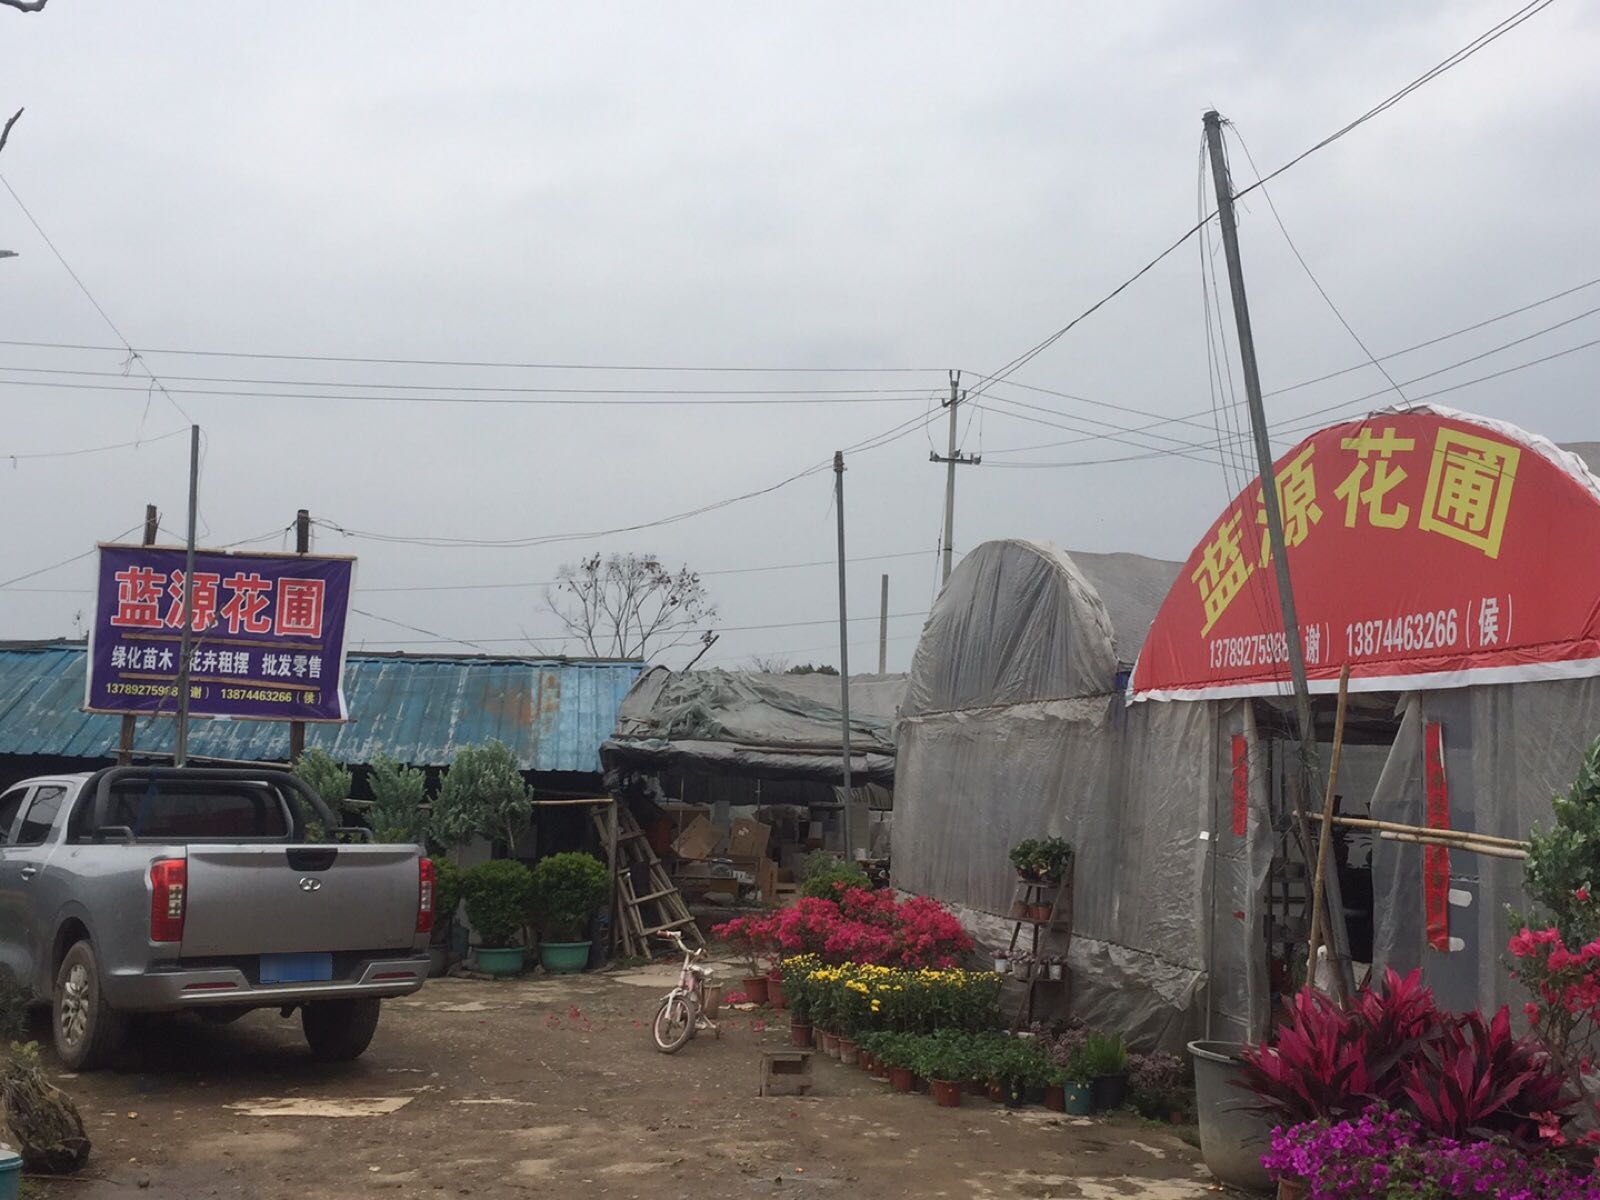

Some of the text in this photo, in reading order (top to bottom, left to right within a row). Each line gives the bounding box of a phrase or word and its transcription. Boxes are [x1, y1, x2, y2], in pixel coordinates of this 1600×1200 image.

[1191, 426, 1521, 638] 蓝源花圃
[110, 565, 325, 639] 蓝源花圃
[110, 645, 323, 679] 绿化苗木 花卉租摆 批发零售
